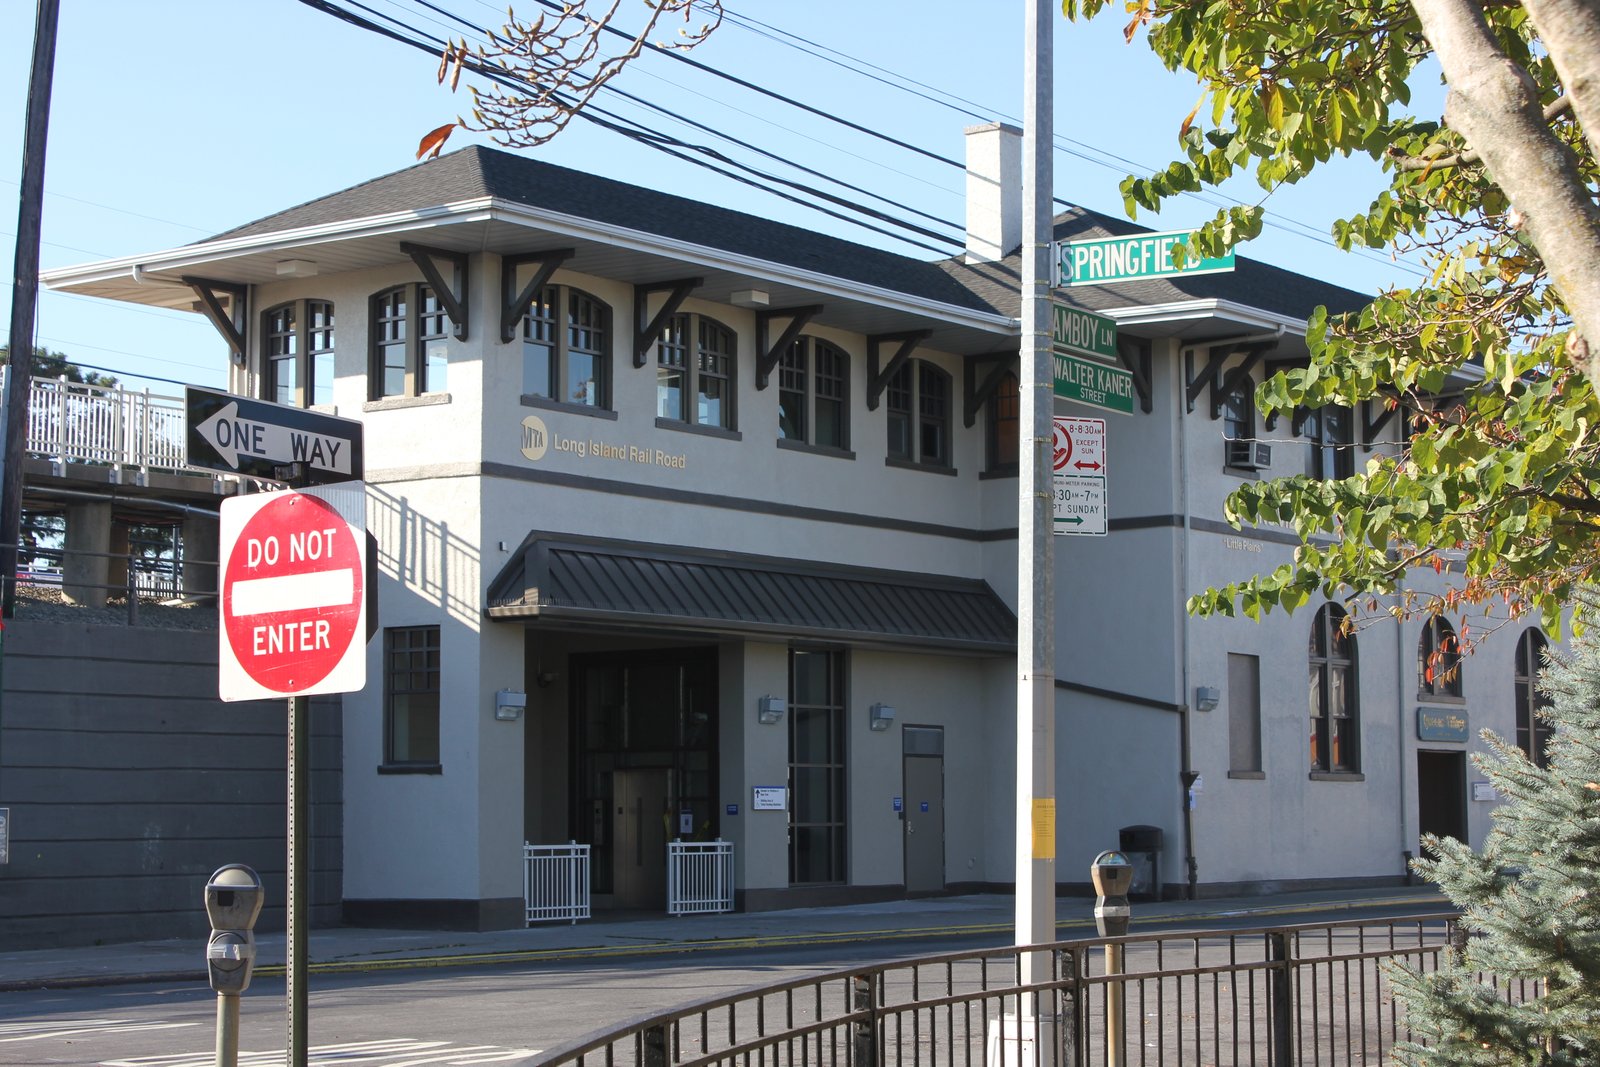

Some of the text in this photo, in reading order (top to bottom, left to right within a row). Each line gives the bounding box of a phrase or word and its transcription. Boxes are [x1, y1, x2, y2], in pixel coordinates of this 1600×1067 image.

[1053, 308, 1113, 350] AMBOY LN
[1053, 357, 1132, 398] WALTER KANER
[1080, 387, 1106, 404] STREET
[216, 418, 342, 468] ONE WAY
[554, 433, 585, 457] Long
[589, 439, 626, 460] Island
[629, 445, 652, 464] Rail
[655, 450, 686, 469] Road
[1076, 439, 1098, 447] EXCEPT
[1067, 504, 1099, 514] SUNDAY
[247, 528, 337, 568] DO NOT
[253, 619, 330, 656] ENTER
